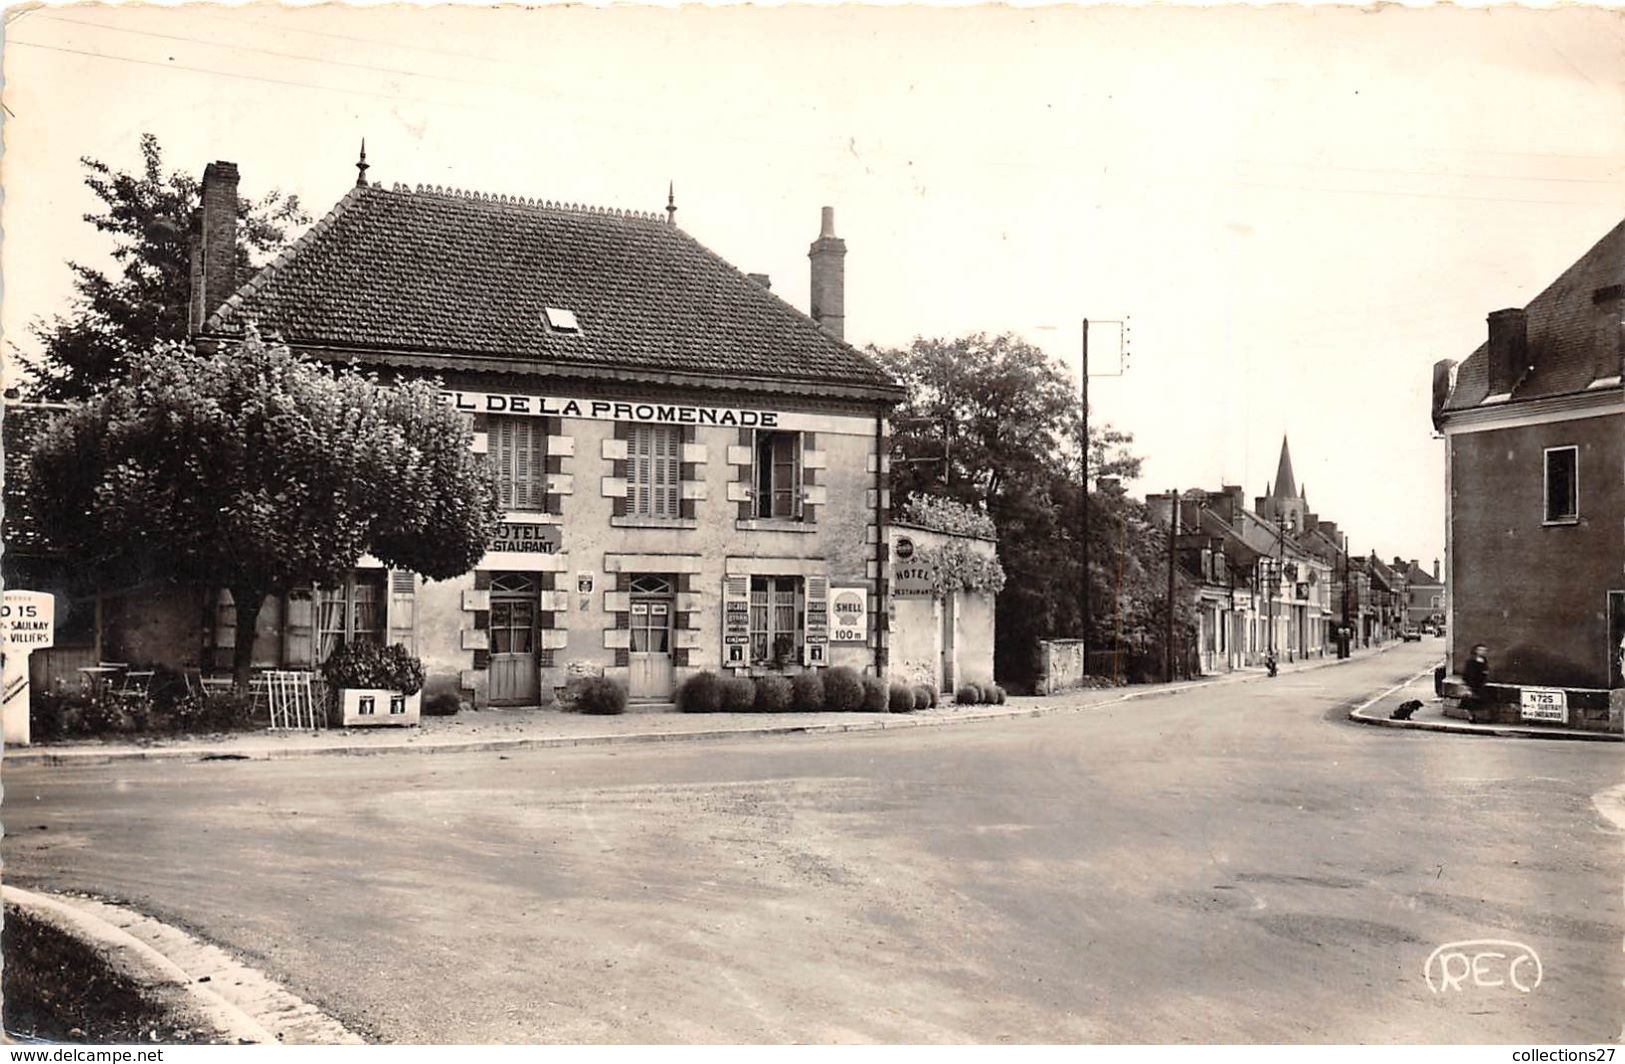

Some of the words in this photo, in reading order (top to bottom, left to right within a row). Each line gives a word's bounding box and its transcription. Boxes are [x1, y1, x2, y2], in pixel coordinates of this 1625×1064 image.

[486, 395, 530, 413] DE
[539, 398, 582, 416] LA
[591, 401, 778, 427] PROMENADE
[487, 541, 554, 552] STAURANT
[896, 569, 929, 581] HOTEL
[19, 605, 37, 617] 15
[836, 603, 862, 613] SHELL
[11, 621, 49, 630] SAULNAY
[10, 633, 49, 643] VILLIERS
[835, 630, 853, 640] 100
